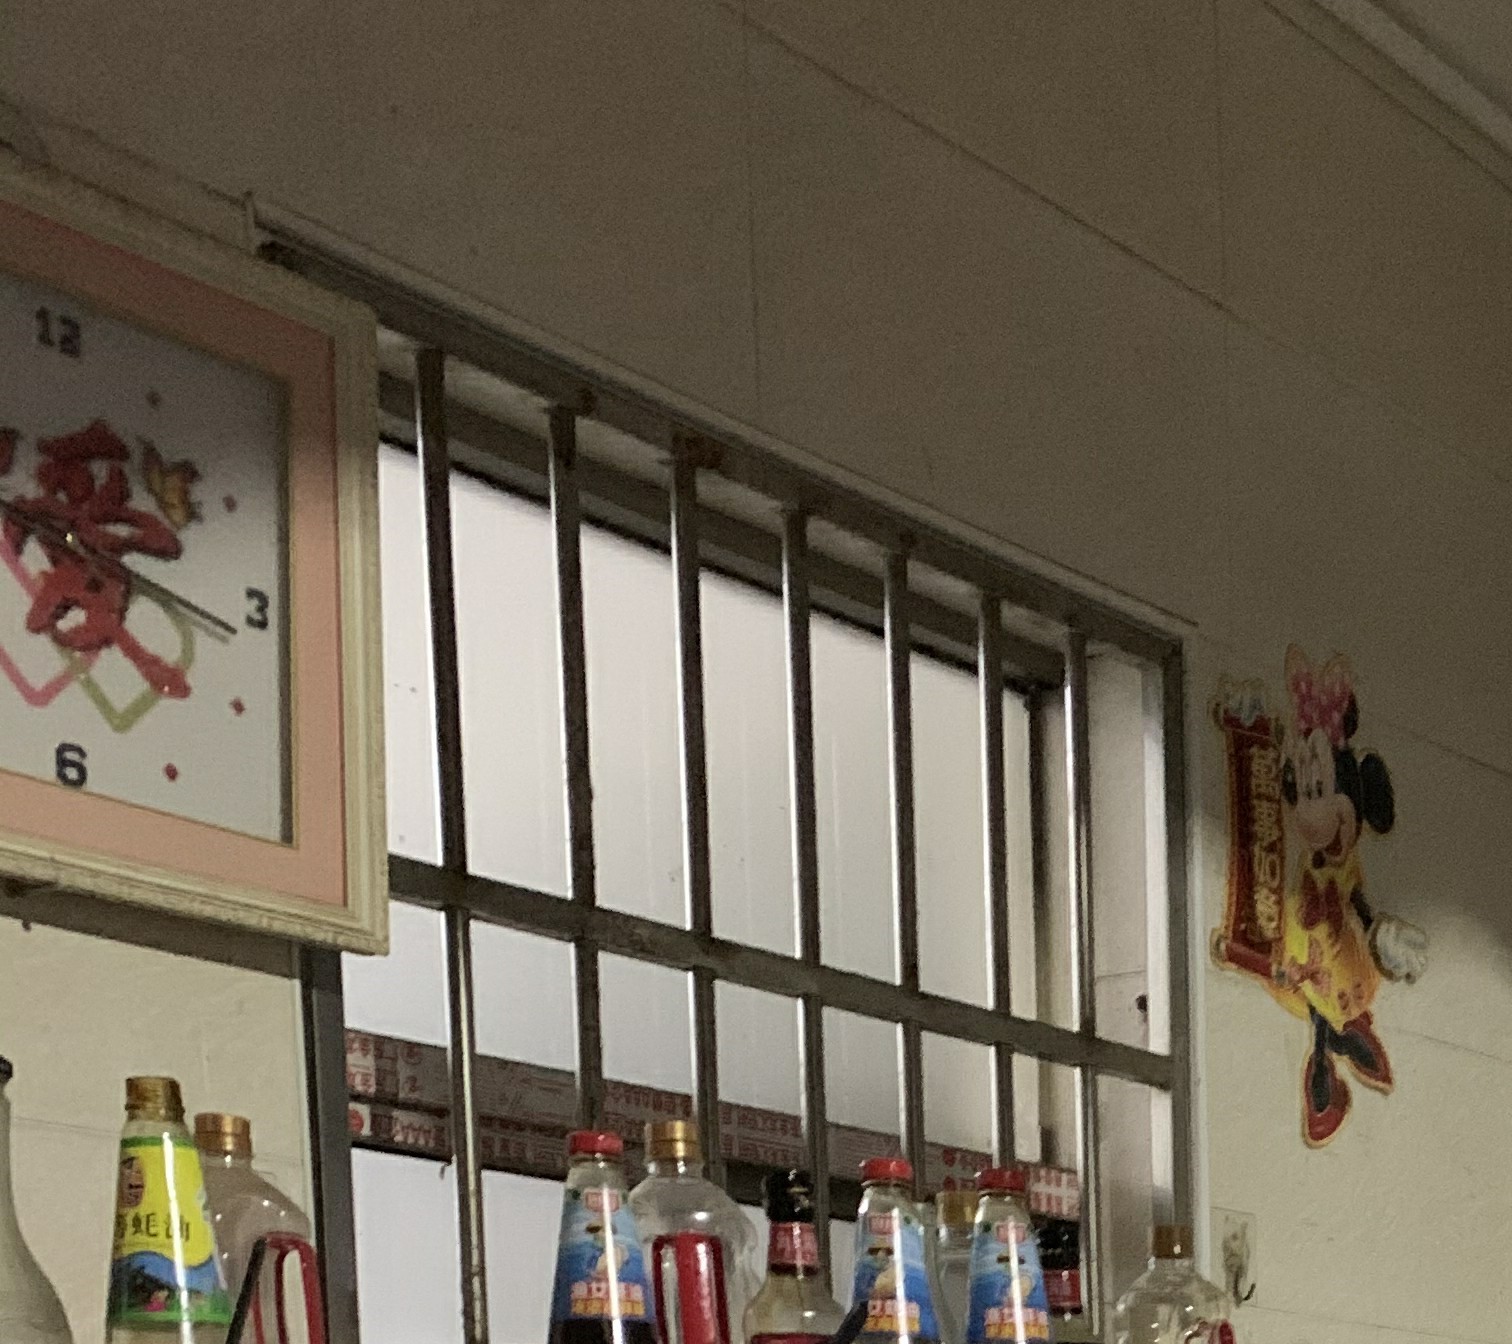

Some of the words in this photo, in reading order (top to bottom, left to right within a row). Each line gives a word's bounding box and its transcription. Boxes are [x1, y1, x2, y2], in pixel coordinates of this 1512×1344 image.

[35, 306, 81, 358] 12
[245, 587, 270, 631] 3
[55, 743, 88, 789] 6
